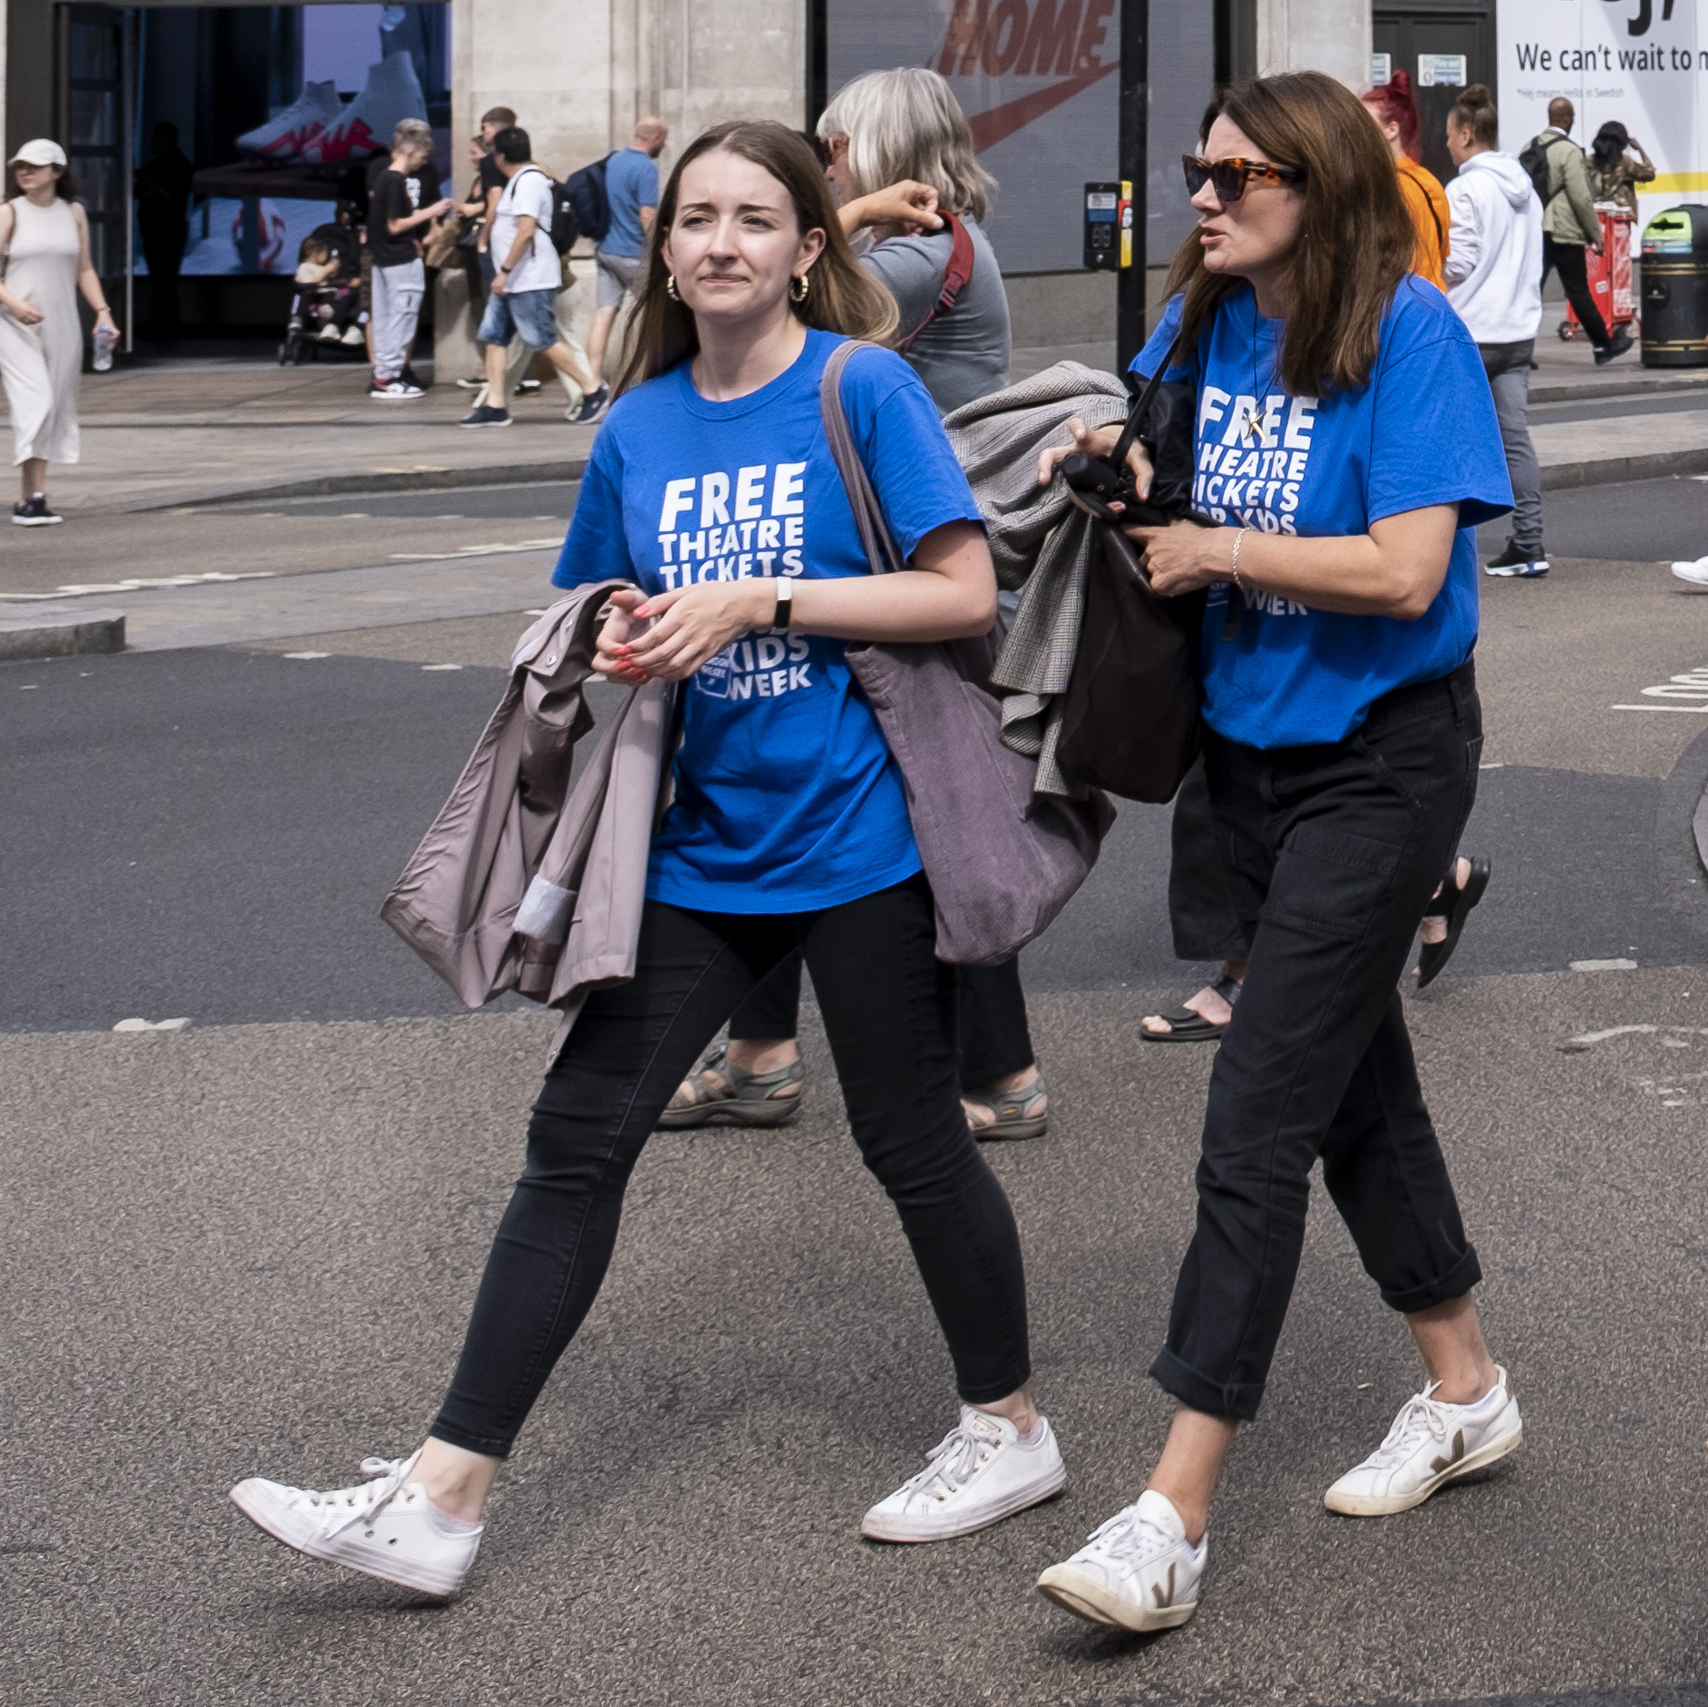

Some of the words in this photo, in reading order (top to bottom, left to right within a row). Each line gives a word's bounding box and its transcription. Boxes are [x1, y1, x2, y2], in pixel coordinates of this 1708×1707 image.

[1515, 42, 1553, 72] We
[1559, 43, 1613, 72] can't
[1619, 42, 1665, 72] wait
[1672, 47, 1693, 72] to
[1199, 385, 1320, 450] FREE
[1198, 442, 1309, 482] HEATRE
[658, 461, 807, 532] FREE
[657, 516, 805, 564] THEATRE
[658, 548, 805, 592] TICKETS
[727, 662, 813, 702] WEEK
